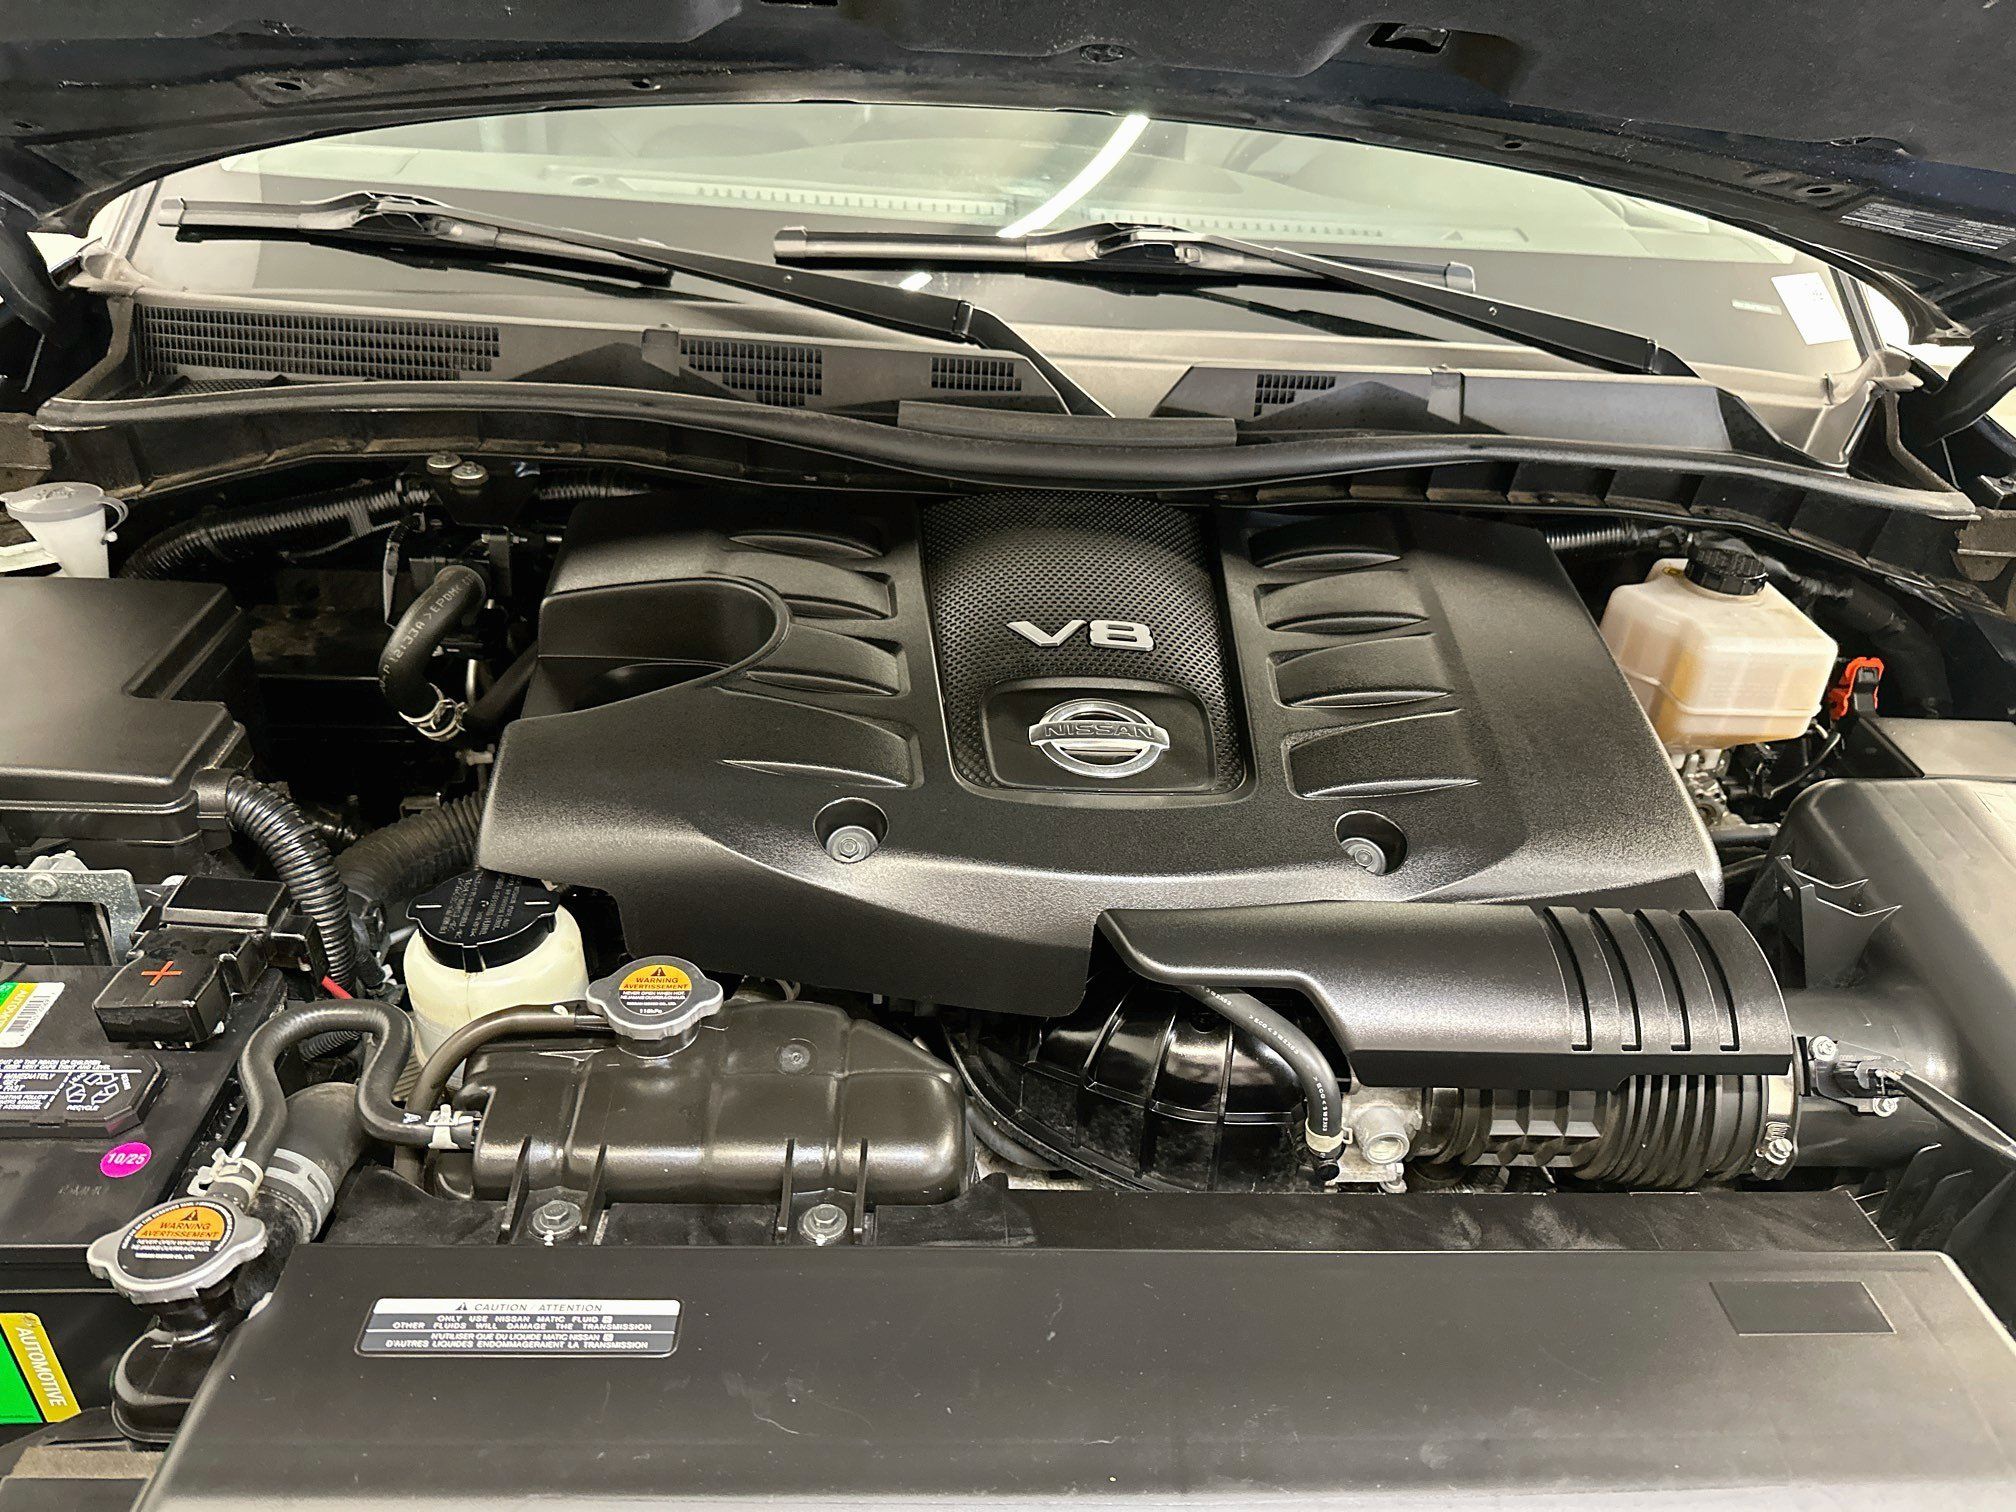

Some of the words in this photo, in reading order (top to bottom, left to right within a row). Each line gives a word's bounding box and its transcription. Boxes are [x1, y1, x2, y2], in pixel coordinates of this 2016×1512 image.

[1006, 619, 1154, 651] V8
[1044, 722, 1156, 740] NISSAN
[107, 1152, 147, 1166] 10/25
[160, 1222, 211, 1230] WARNING
[141, 1230, 219, 1239] AVERTISSEMENT
[474, 1303, 528, 1312] CAUTION
[538, 1303, 603, 1312] ATTENTION
[436, 1315, 463, 1323] ONLY
[468, 1315, 489, 1323] USE
[495, 1315, 531, 1323] NISSAN
[536, 1315, 566, 1323] MATIC
[571, 1315, 599, 1323] FLUID
[392, 1321, 426, 1330] OTHER
[433, 1322, 467, 1330] FLUIDS
[475, 1322, 498, 1330] WILL
[506, 1322, 547, 1330] DAMAGE
[555, 1322, 573, 1330] THE
[582, 1323, 652, 1331] TRANSMISSION
[509, 1332, 542, 1341] LIQUIDE
[542, 1333, 568, 1341] MATIC
[568, 1333, 600, 1342] NISSAN
[431, 1340, 474, 1348] LIQUIDES
[476, 1340, 565, 1349] ENDOMMAGERAIENT
[567, 1341, 580, 1349] LA
[583, 1341, 649, 1349] TRANSMISSION
[16, 1326, 68, 1407] AUTOMOTIVE
